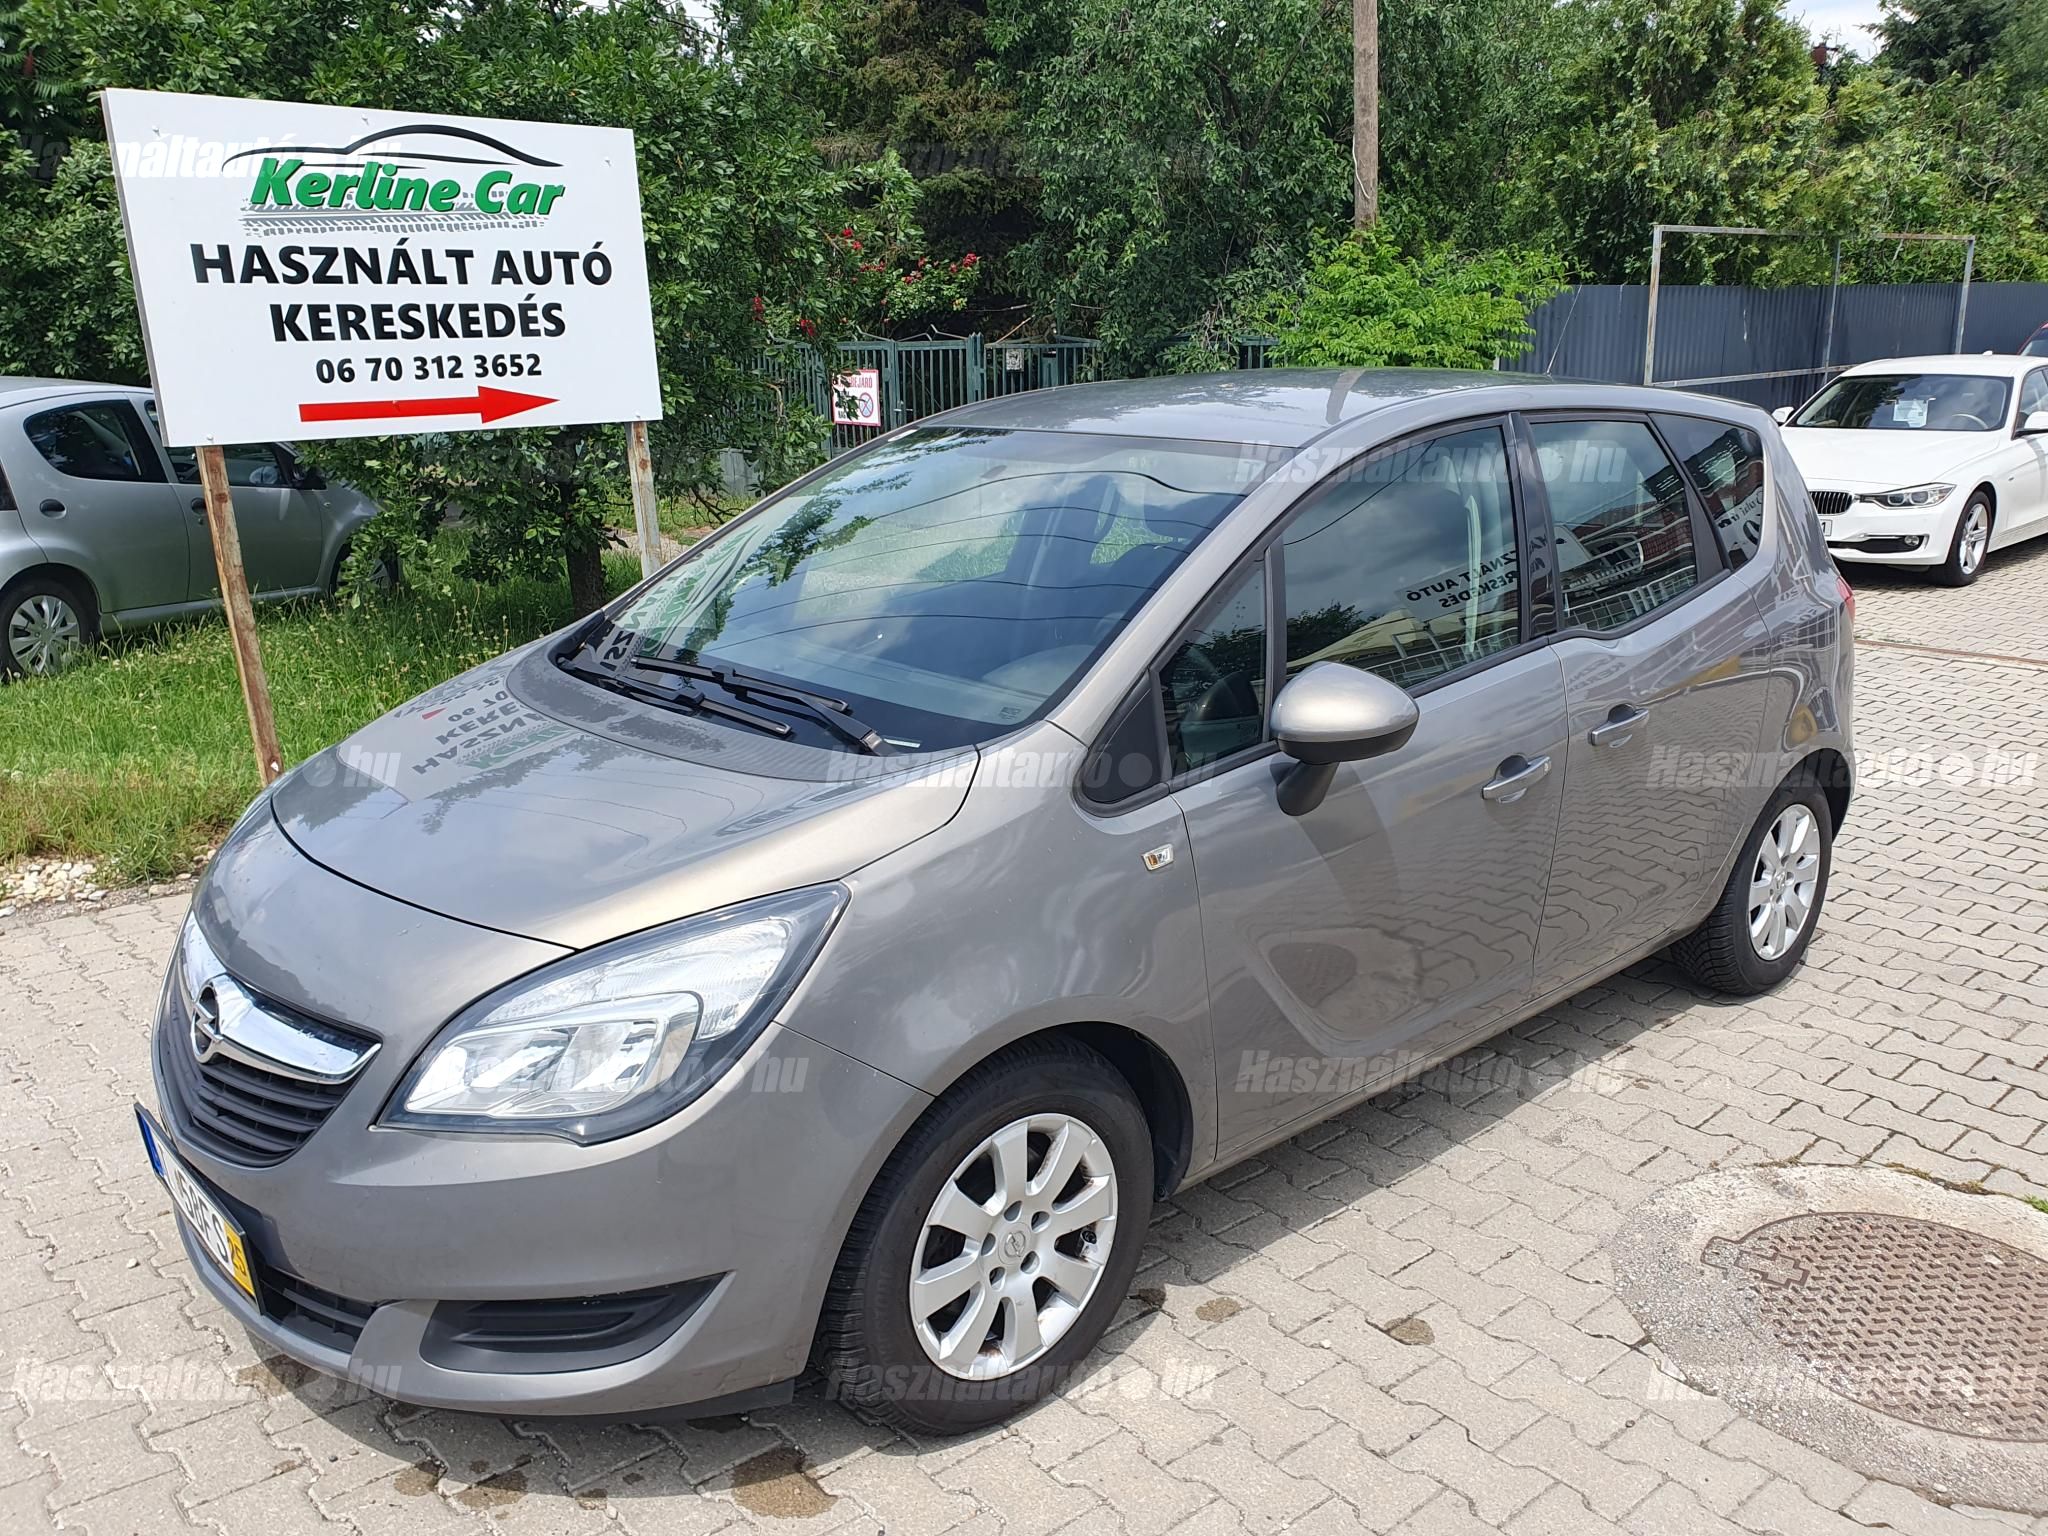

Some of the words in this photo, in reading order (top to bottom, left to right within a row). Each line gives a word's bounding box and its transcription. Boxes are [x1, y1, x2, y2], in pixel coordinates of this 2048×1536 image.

[250, 158, 461, 213] Kerline
[475, 170, 566, 216] Car
[190, 238, 474, 285] HASZNÁLT
[491, 241, 613, 286] AUTÓ
[269, 294, 567, 342] KERESKEDÉS
[316, 358, 356, 383] 06
[365, 356, 403, 382] 70
[414, 355, 464, 380] 312
[474, 353, 543, 378] 3652
